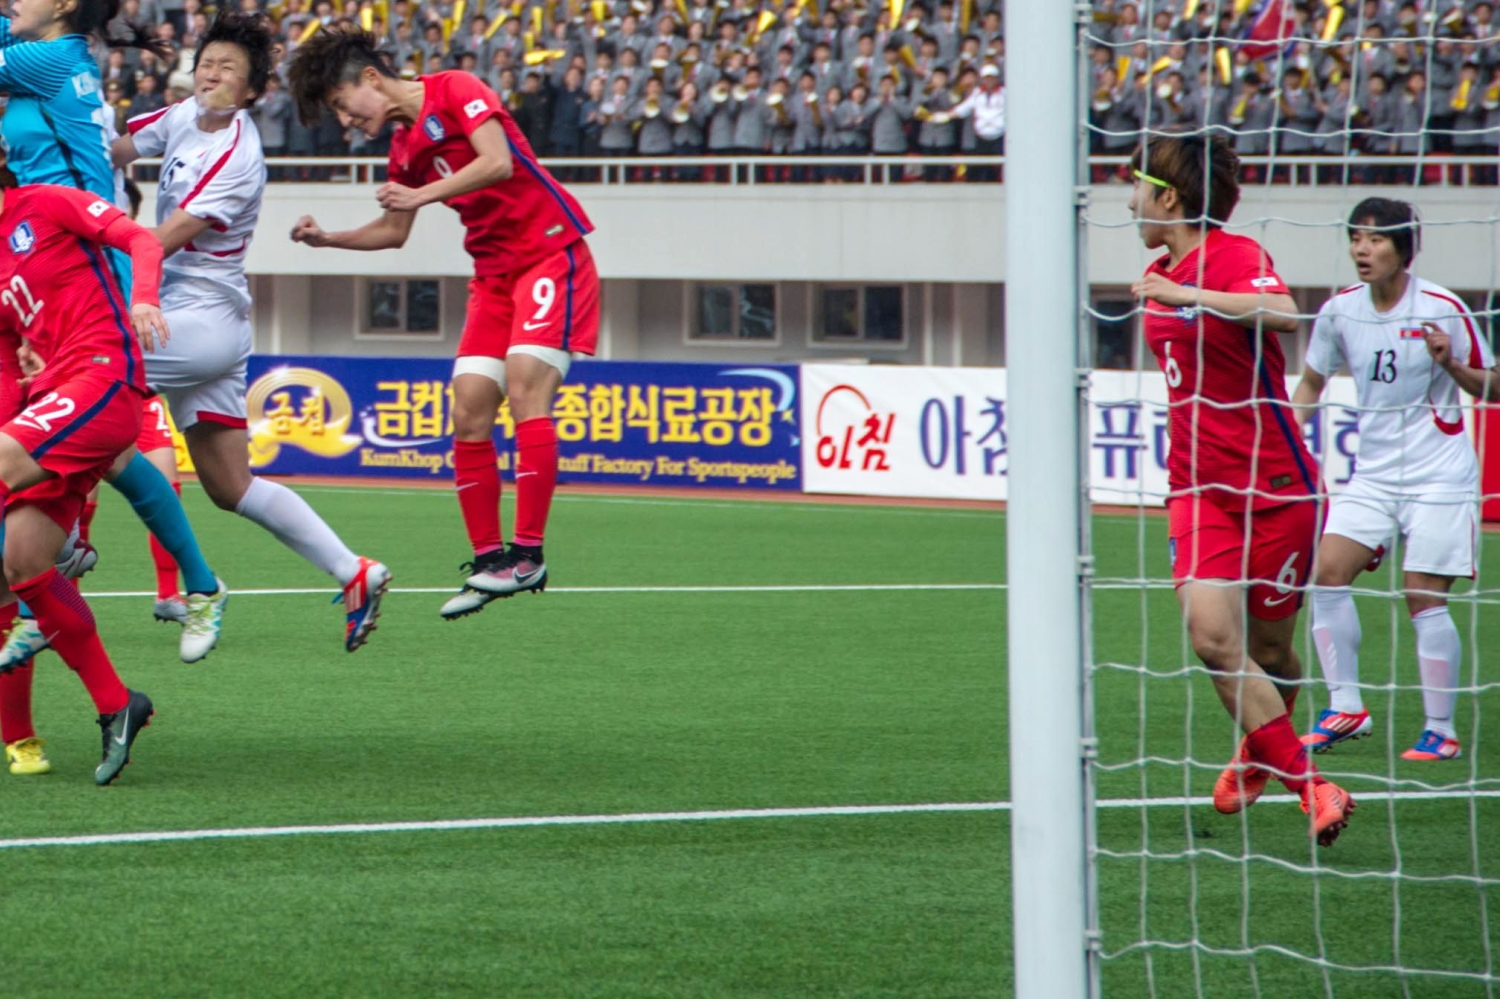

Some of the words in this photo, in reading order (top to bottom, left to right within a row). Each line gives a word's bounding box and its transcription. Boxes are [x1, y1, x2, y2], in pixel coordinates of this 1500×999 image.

[2, 274, 45, 327] 22
[532, 277, 556, 320] 9
[1164, 340, 1183, 388] 6
[1369, 348, 1397, 384] 13
[21, 391, 76, 432] 22
[360, 448, 443, 474] KumKhop
[592, 454, 653, 481] Factory
[656, 456, 685, 476] For
[686, 457, 797, 484] Sportspeople
[1275, 550, 1300, 595] 6
